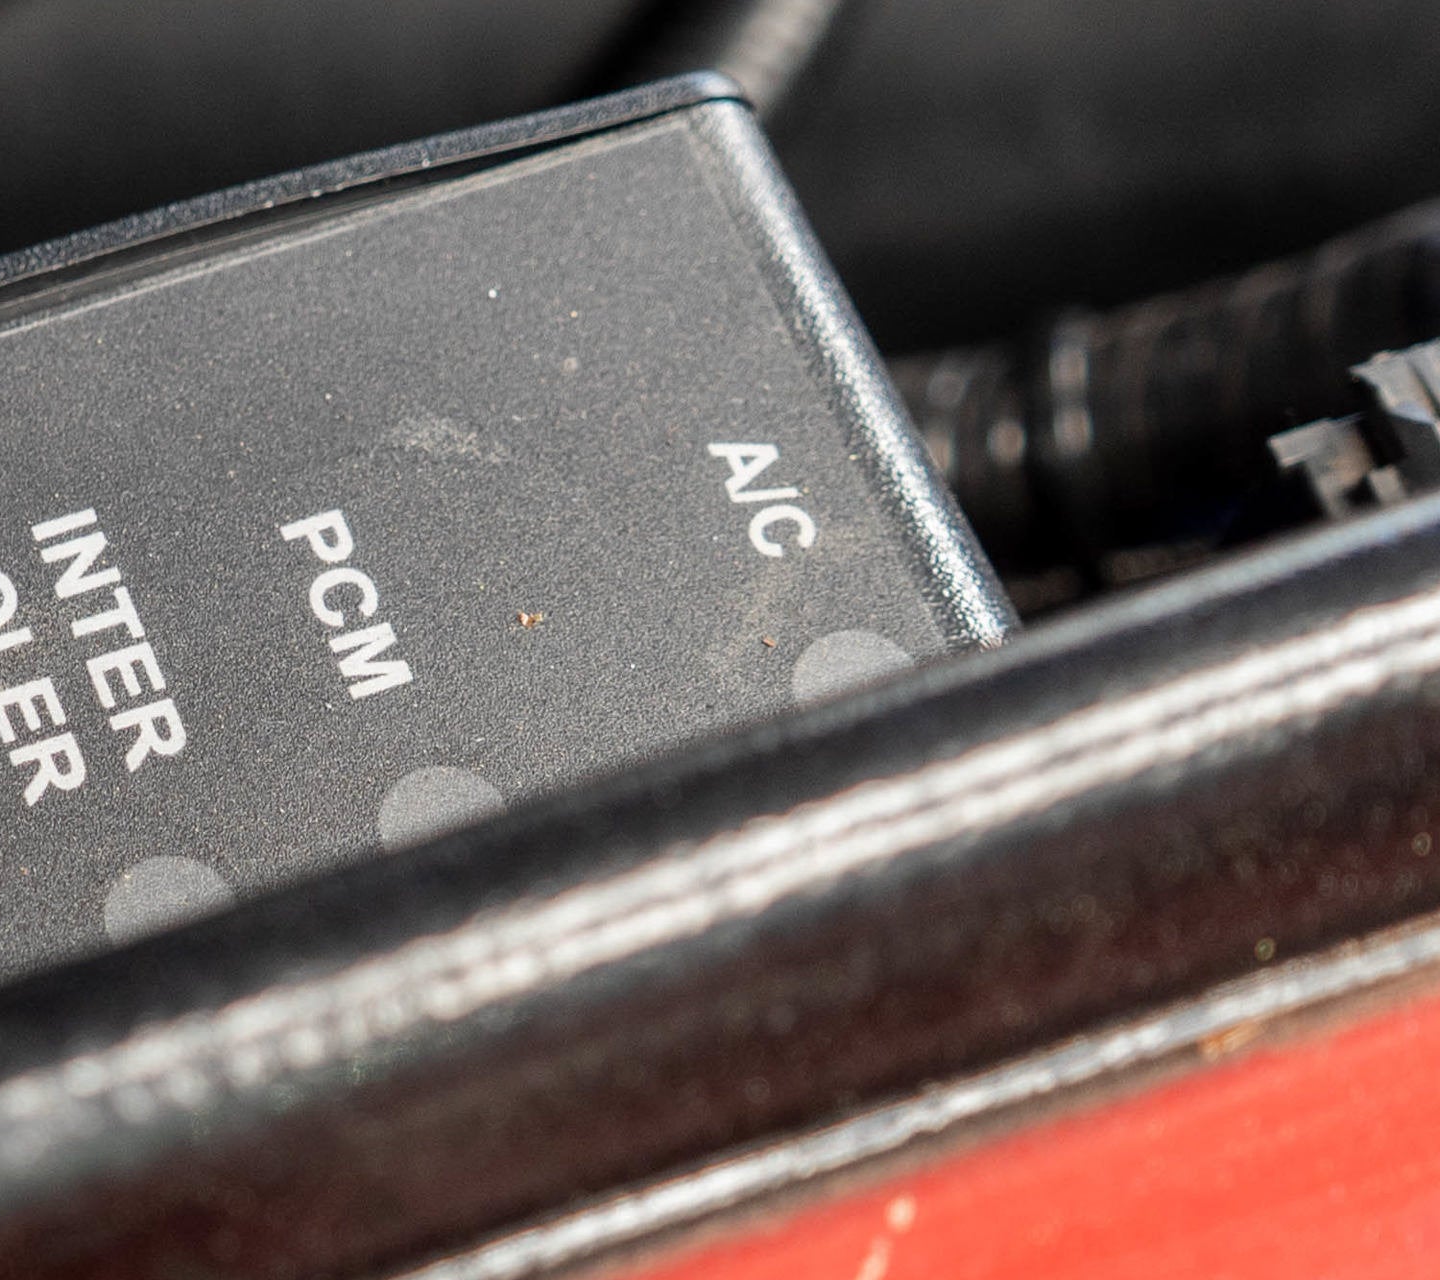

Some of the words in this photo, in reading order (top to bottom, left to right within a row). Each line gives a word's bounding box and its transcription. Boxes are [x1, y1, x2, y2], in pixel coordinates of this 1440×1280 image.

[700, 436, 819, 562] A/C
[31, 508, 192, 780] INTER
[275, 506, 422, 705] PCM
